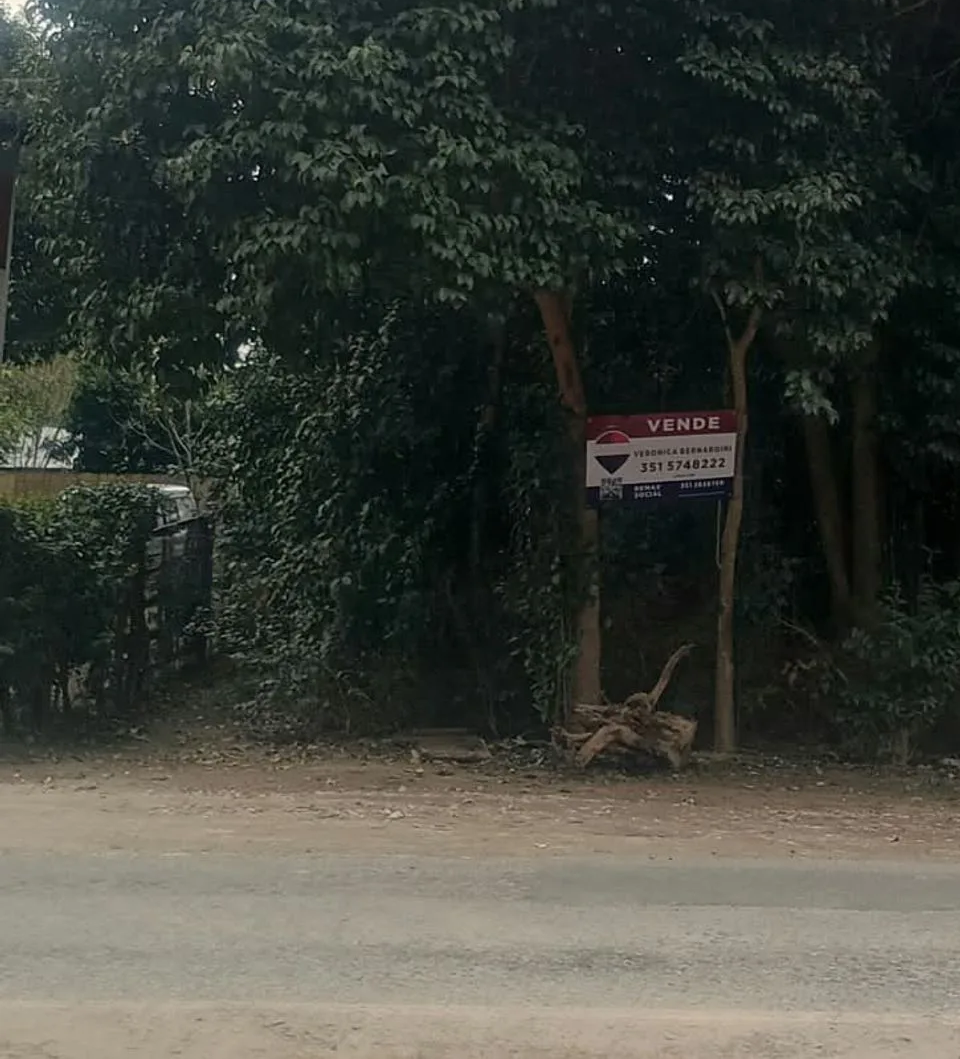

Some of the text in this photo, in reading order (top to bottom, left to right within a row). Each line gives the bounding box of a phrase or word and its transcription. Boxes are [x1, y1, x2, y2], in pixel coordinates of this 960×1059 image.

[647, 417, 721, 432] VENDE
[640, 458, 726, 473] 351 5748222
